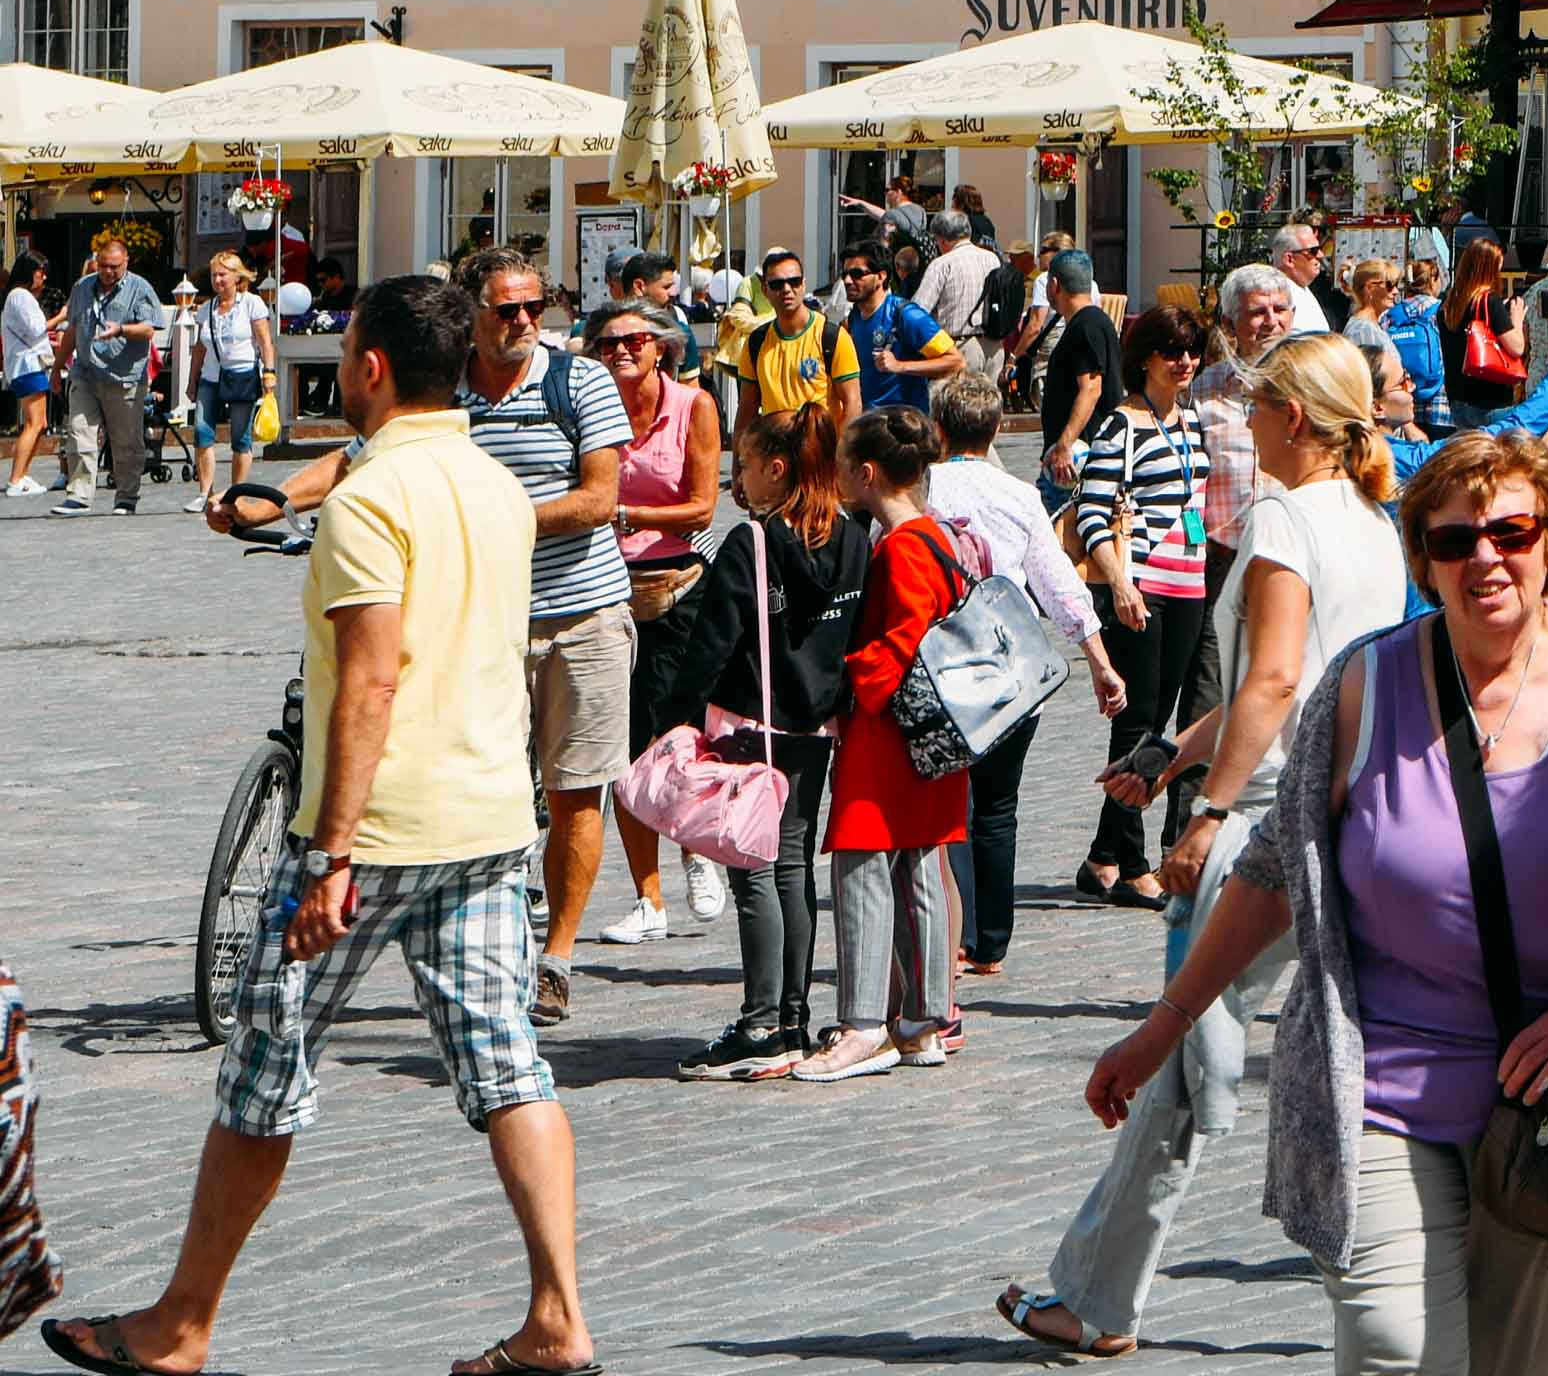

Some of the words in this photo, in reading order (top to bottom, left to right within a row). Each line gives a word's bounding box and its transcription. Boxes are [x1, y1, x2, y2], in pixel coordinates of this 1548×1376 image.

[845, 118, 884, 139] saku
[945, 114, 984, 136] saku
[1043, 109, 1082, 130] saku
[767, 120, 788, 140] ku
[24, 142, 66, 160] saku
[123, 140, 163, 159] saku
[319, 135, 357, 155] saku
[416, 133, 453, 152] saku
[499, 133, 534, 153] saku
[581, 132, 615, 153] saku
[726, 154, 761, 182] aku
